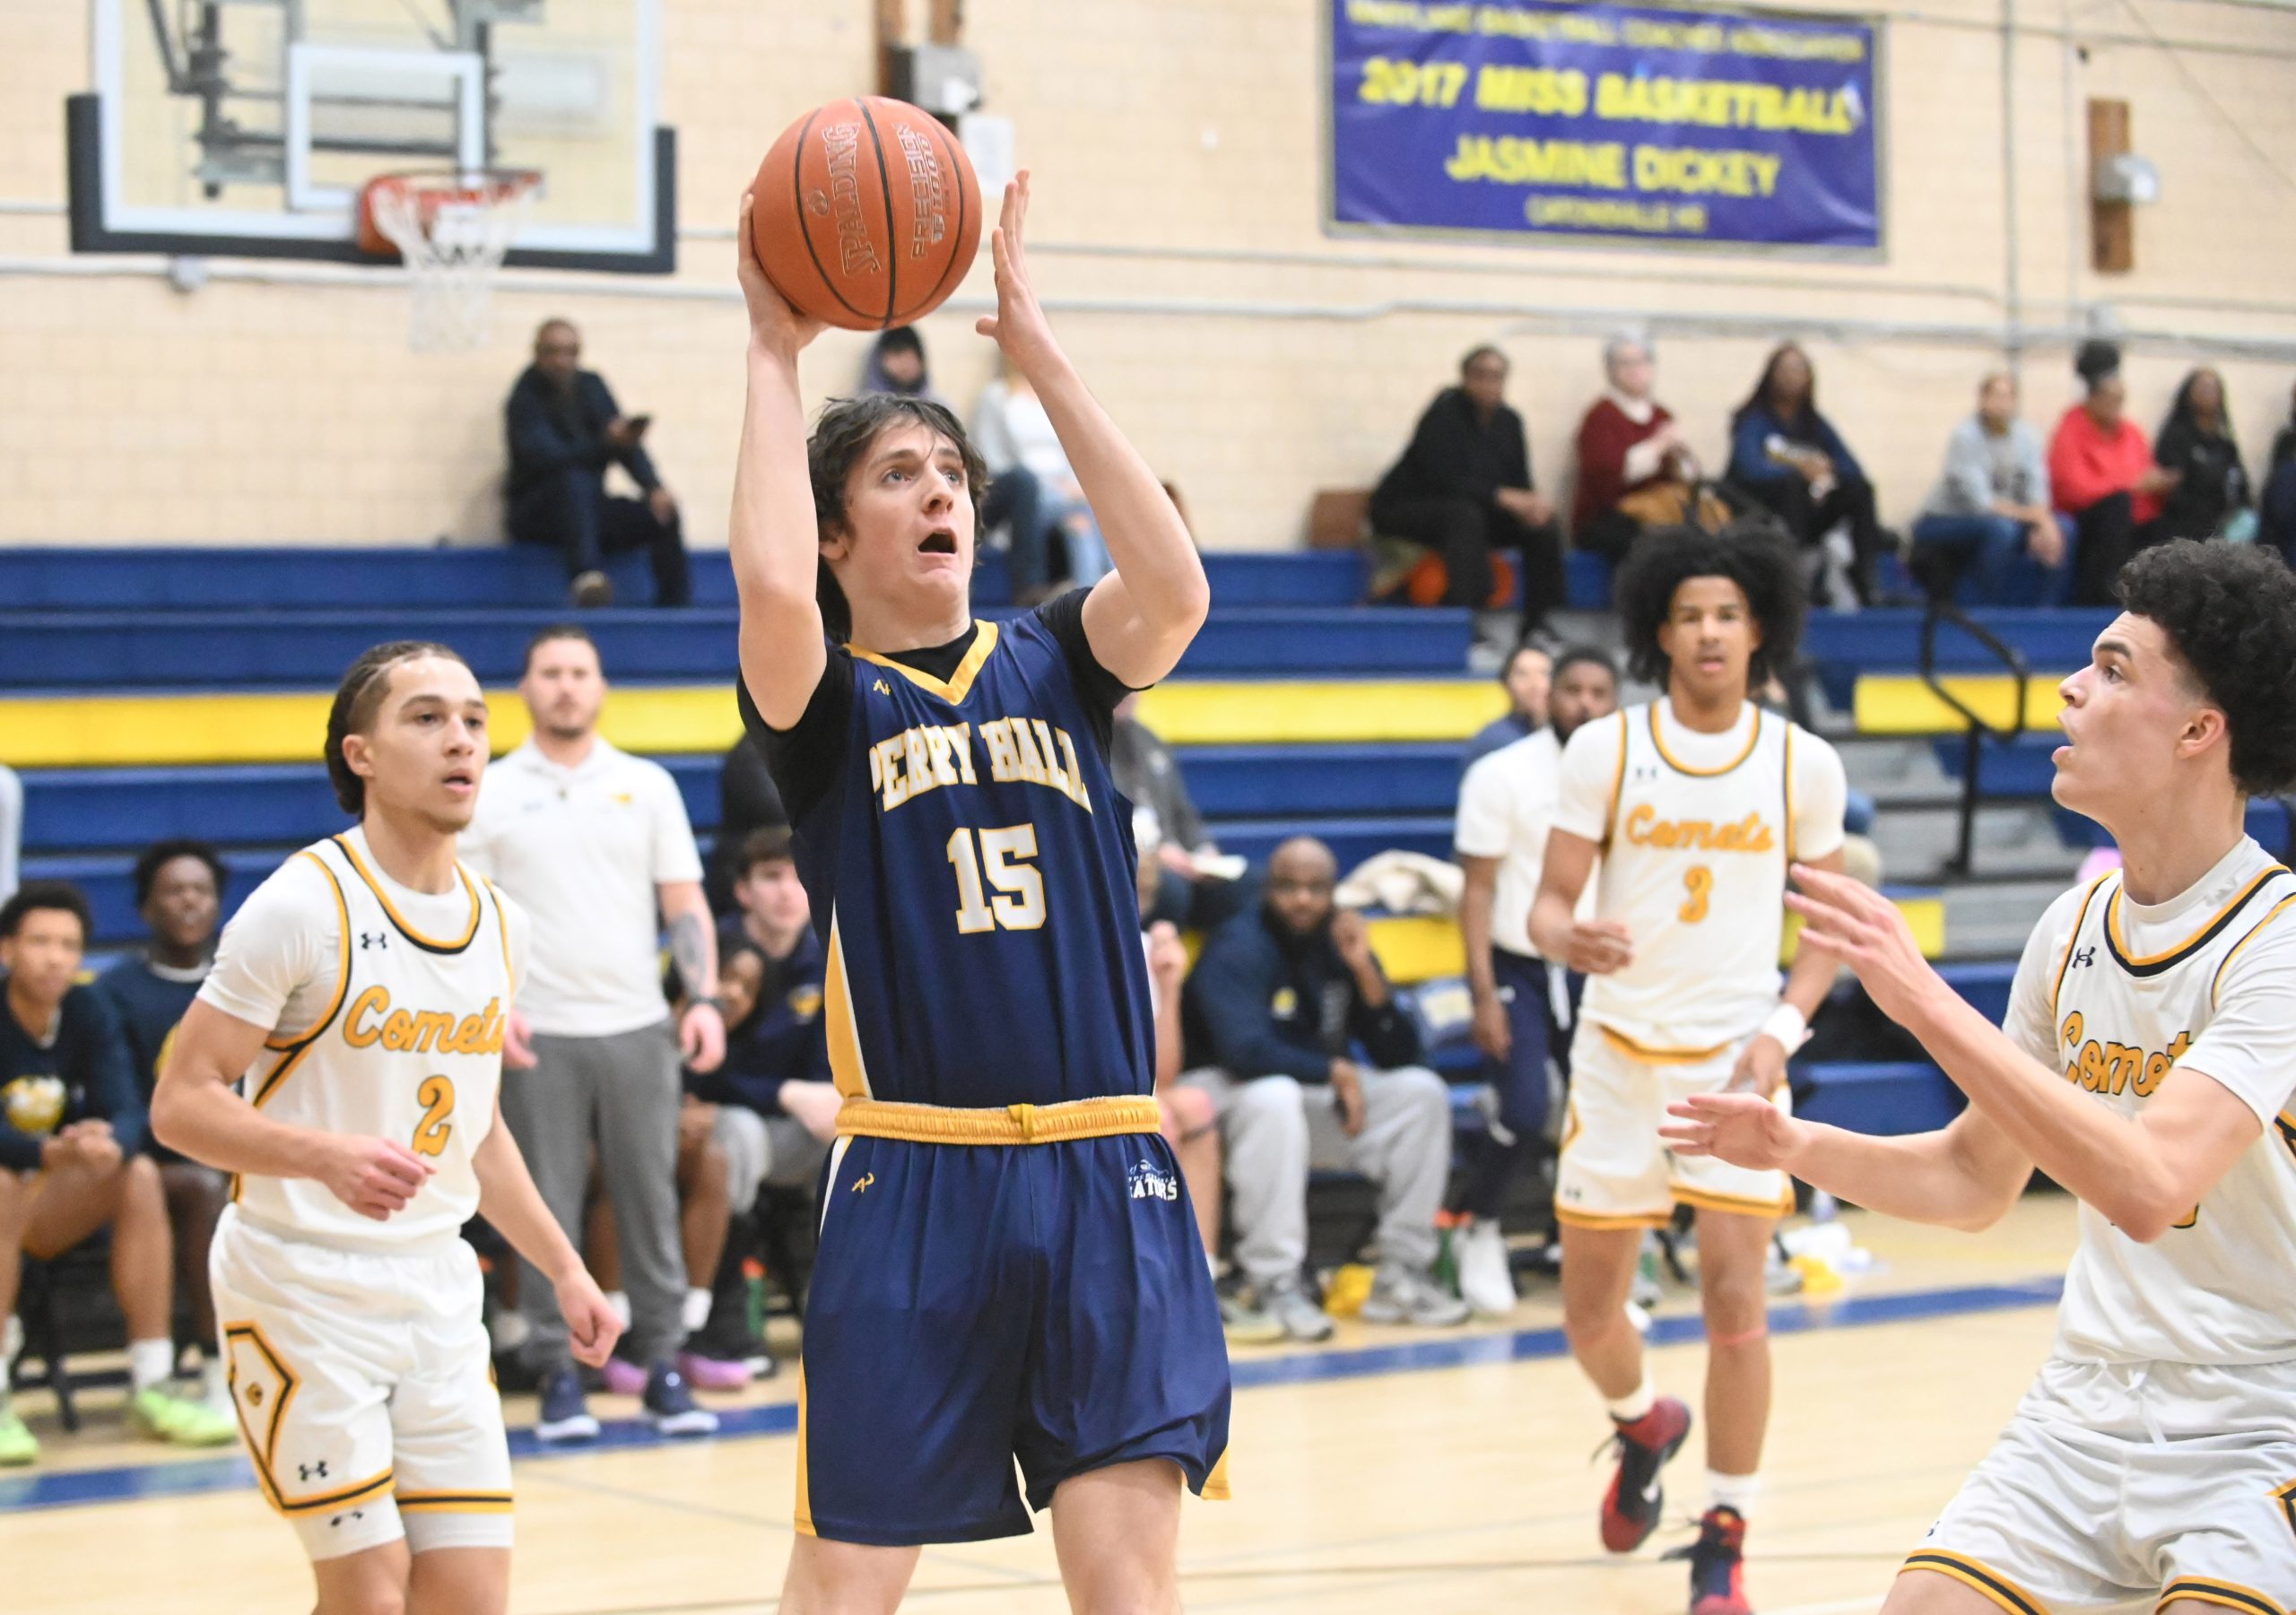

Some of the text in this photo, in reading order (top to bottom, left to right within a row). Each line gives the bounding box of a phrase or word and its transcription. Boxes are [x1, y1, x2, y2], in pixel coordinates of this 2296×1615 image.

[1361, 57, 1860, 135] 2017 MISS BASKETBALL
[822, 122, 881, 276] SPALDING
[891, 122, 931, 259] PRECISION
[1445, 135, 1781, 197] JASMINE DICKEY
[978, 716, 1093, 814] HALL
[1625, 803, 1774, 854] Comets
[946, 822, 1048, 934] 15
[1677, 865, 1713, 925] 3
[2061, 1010, 2194, 1098] Comet
[412, 1074, 455, 1157] 2
